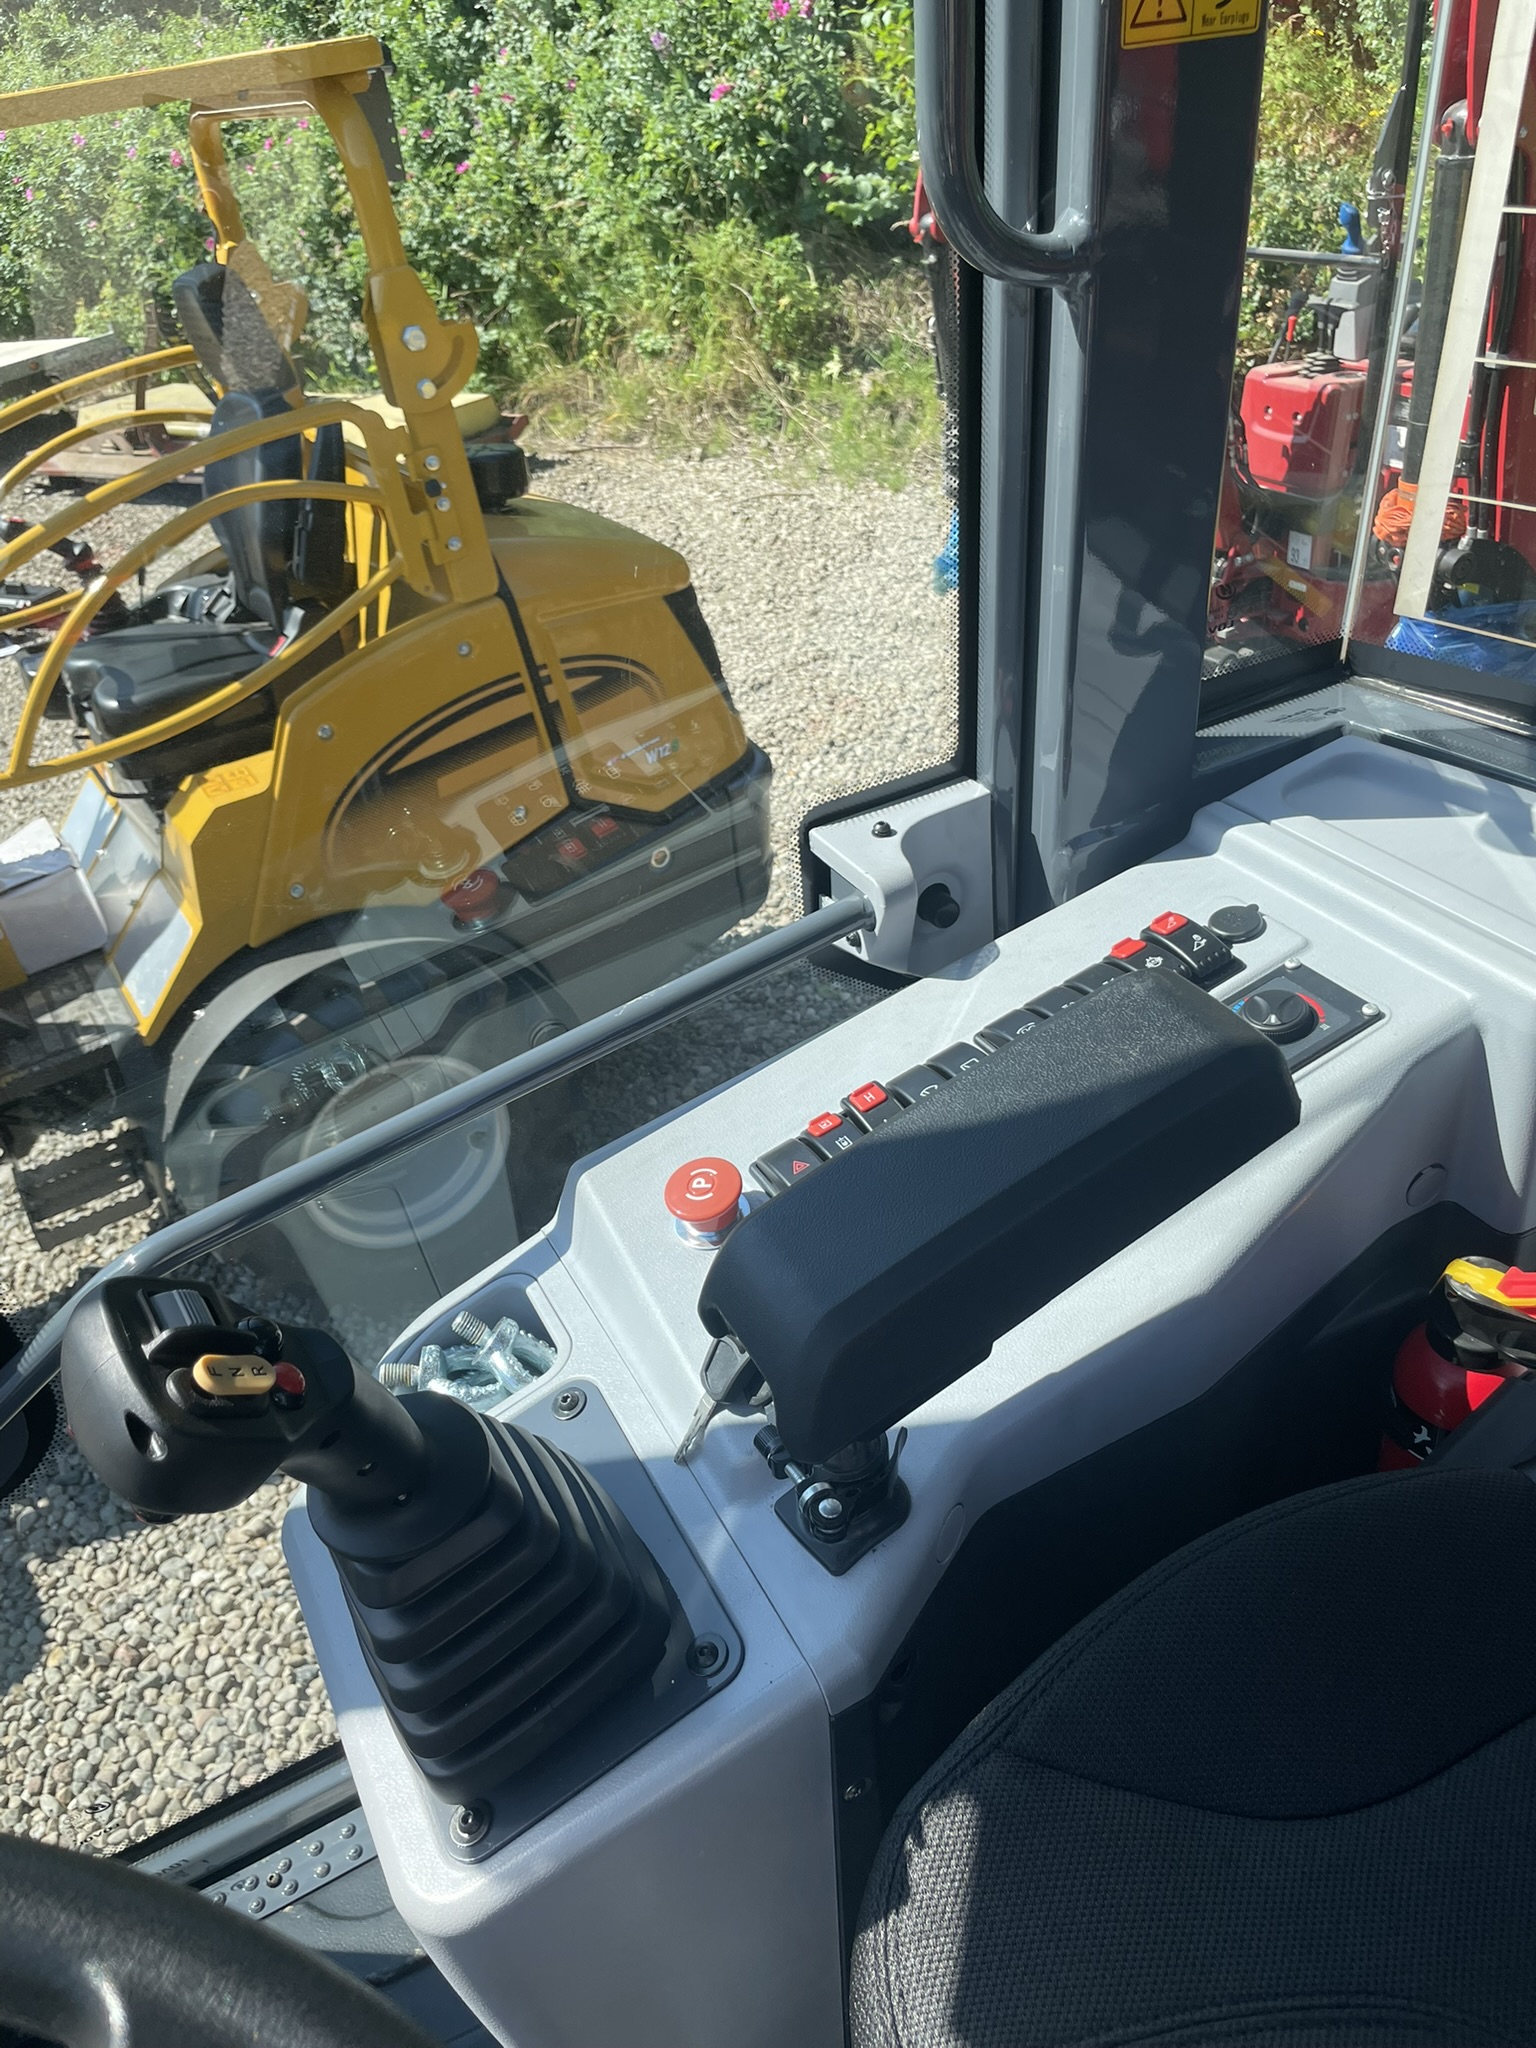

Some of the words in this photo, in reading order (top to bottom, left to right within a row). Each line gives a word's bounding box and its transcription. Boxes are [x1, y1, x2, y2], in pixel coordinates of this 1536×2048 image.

[1219, 11, 1250, 26] Earplugs
[206, 1366, 223, 1377] F
[251, 1365, 268, 1377] R
